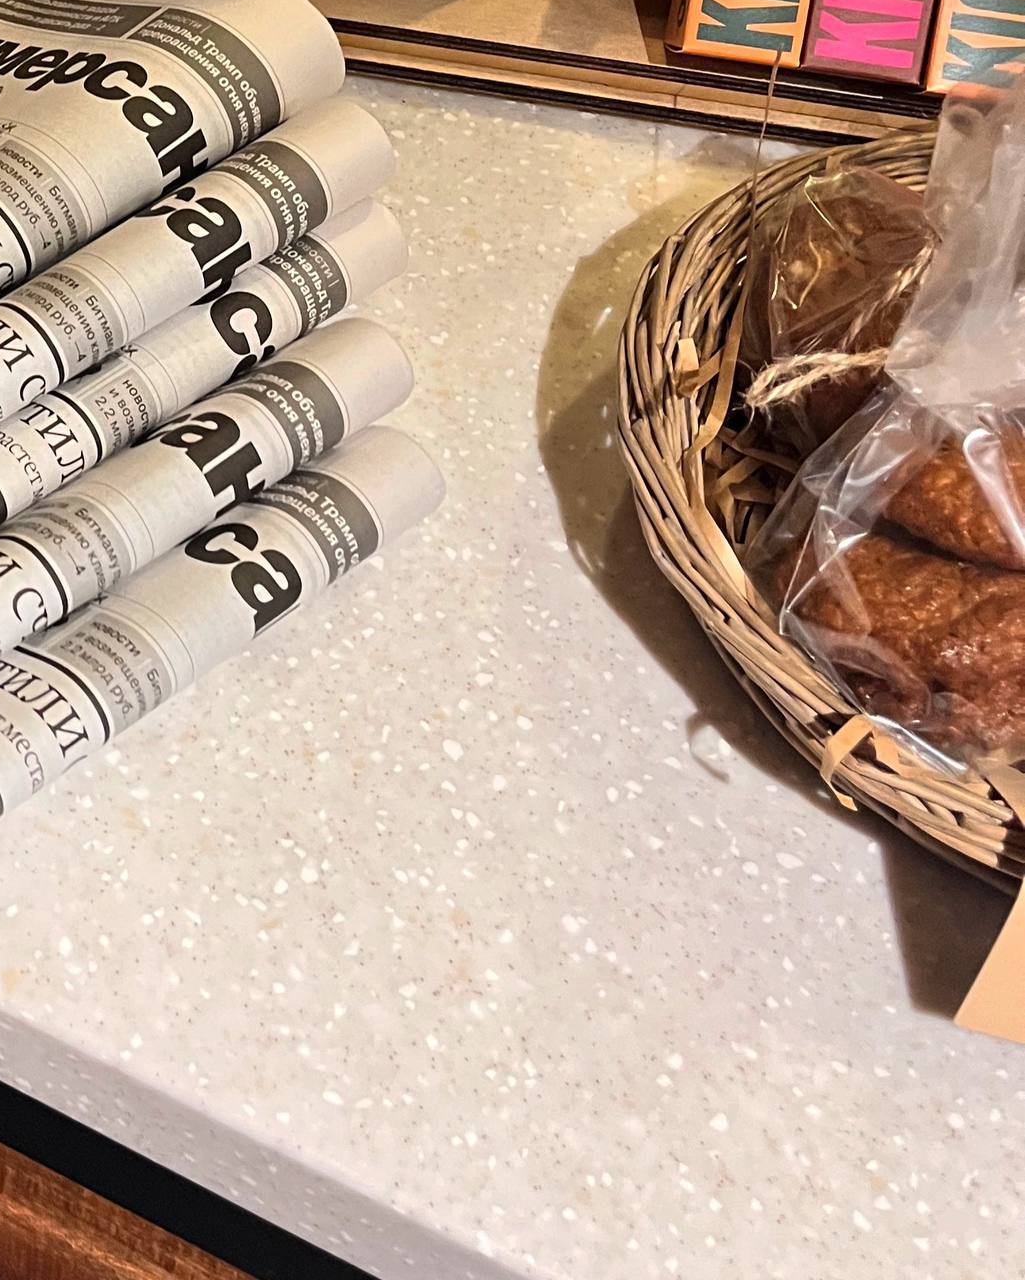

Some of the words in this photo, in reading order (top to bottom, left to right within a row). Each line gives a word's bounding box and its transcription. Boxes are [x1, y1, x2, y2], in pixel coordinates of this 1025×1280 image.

[201, 38, 244, 82] Трамп
[218, 76, 244, 112] огня
[0, 146, 44, 179] новости
[254, 153, 298, 193] Трамп
[16, 199, 41, 229] руб.
[270, 187, 295, 226] огня
[295, 239, 333, 280] овости
[122, 380, 150, 432] новост
[265, 385, 299, 424] огня
[319, 496, 361, 556] Трамп
